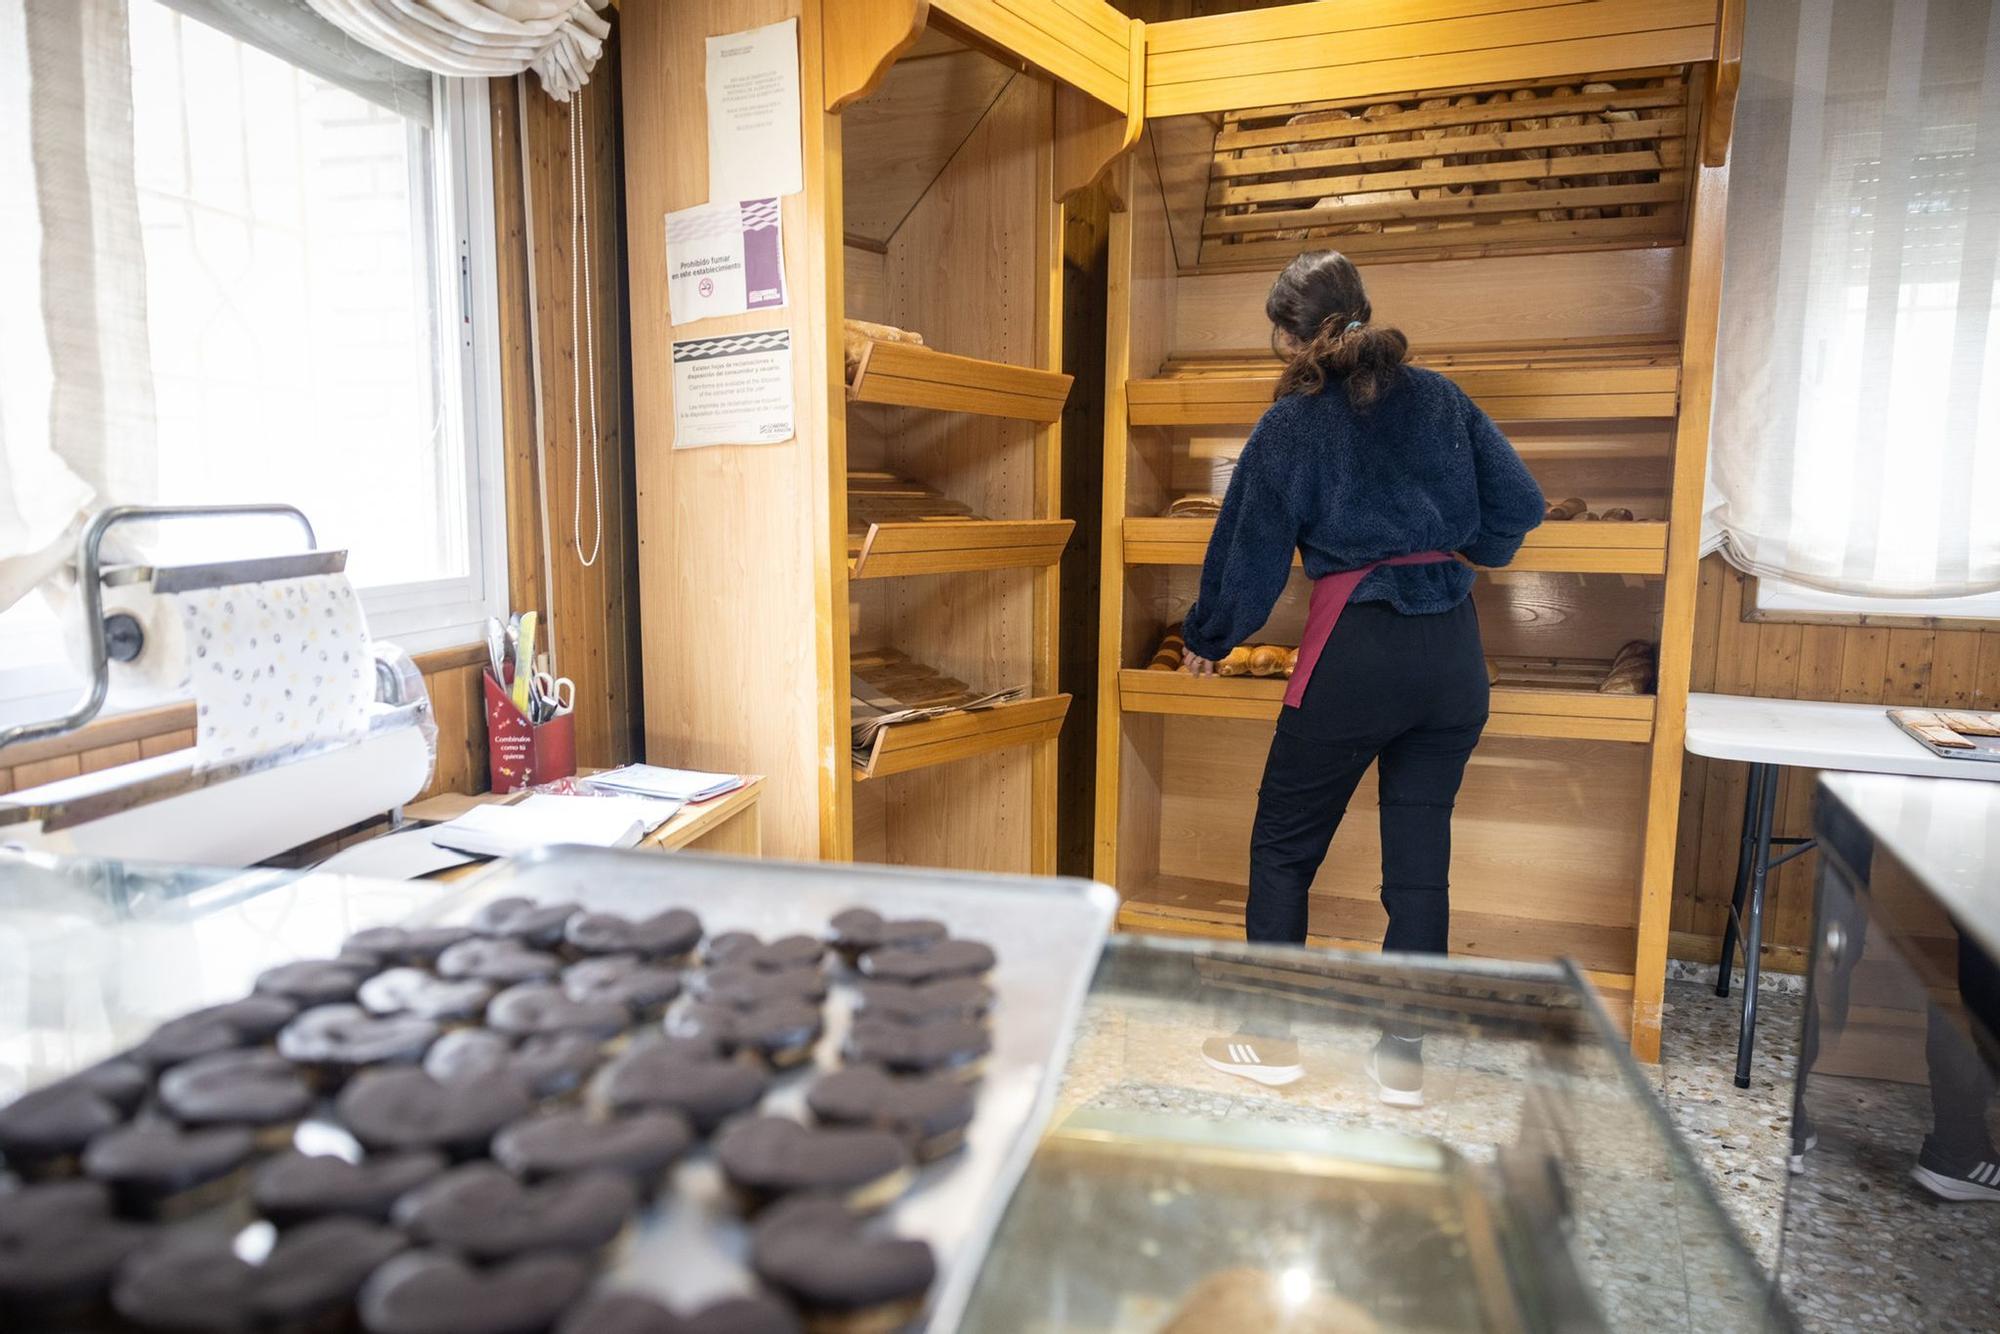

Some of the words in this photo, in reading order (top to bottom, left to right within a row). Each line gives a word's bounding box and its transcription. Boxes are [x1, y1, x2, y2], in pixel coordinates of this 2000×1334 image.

[680, 258, 710, 270] Prohibido
[711, 255, 730, 264] fumar
[680, 270, 692, 278] este
[693, 262, 741, 276] establecimiento
